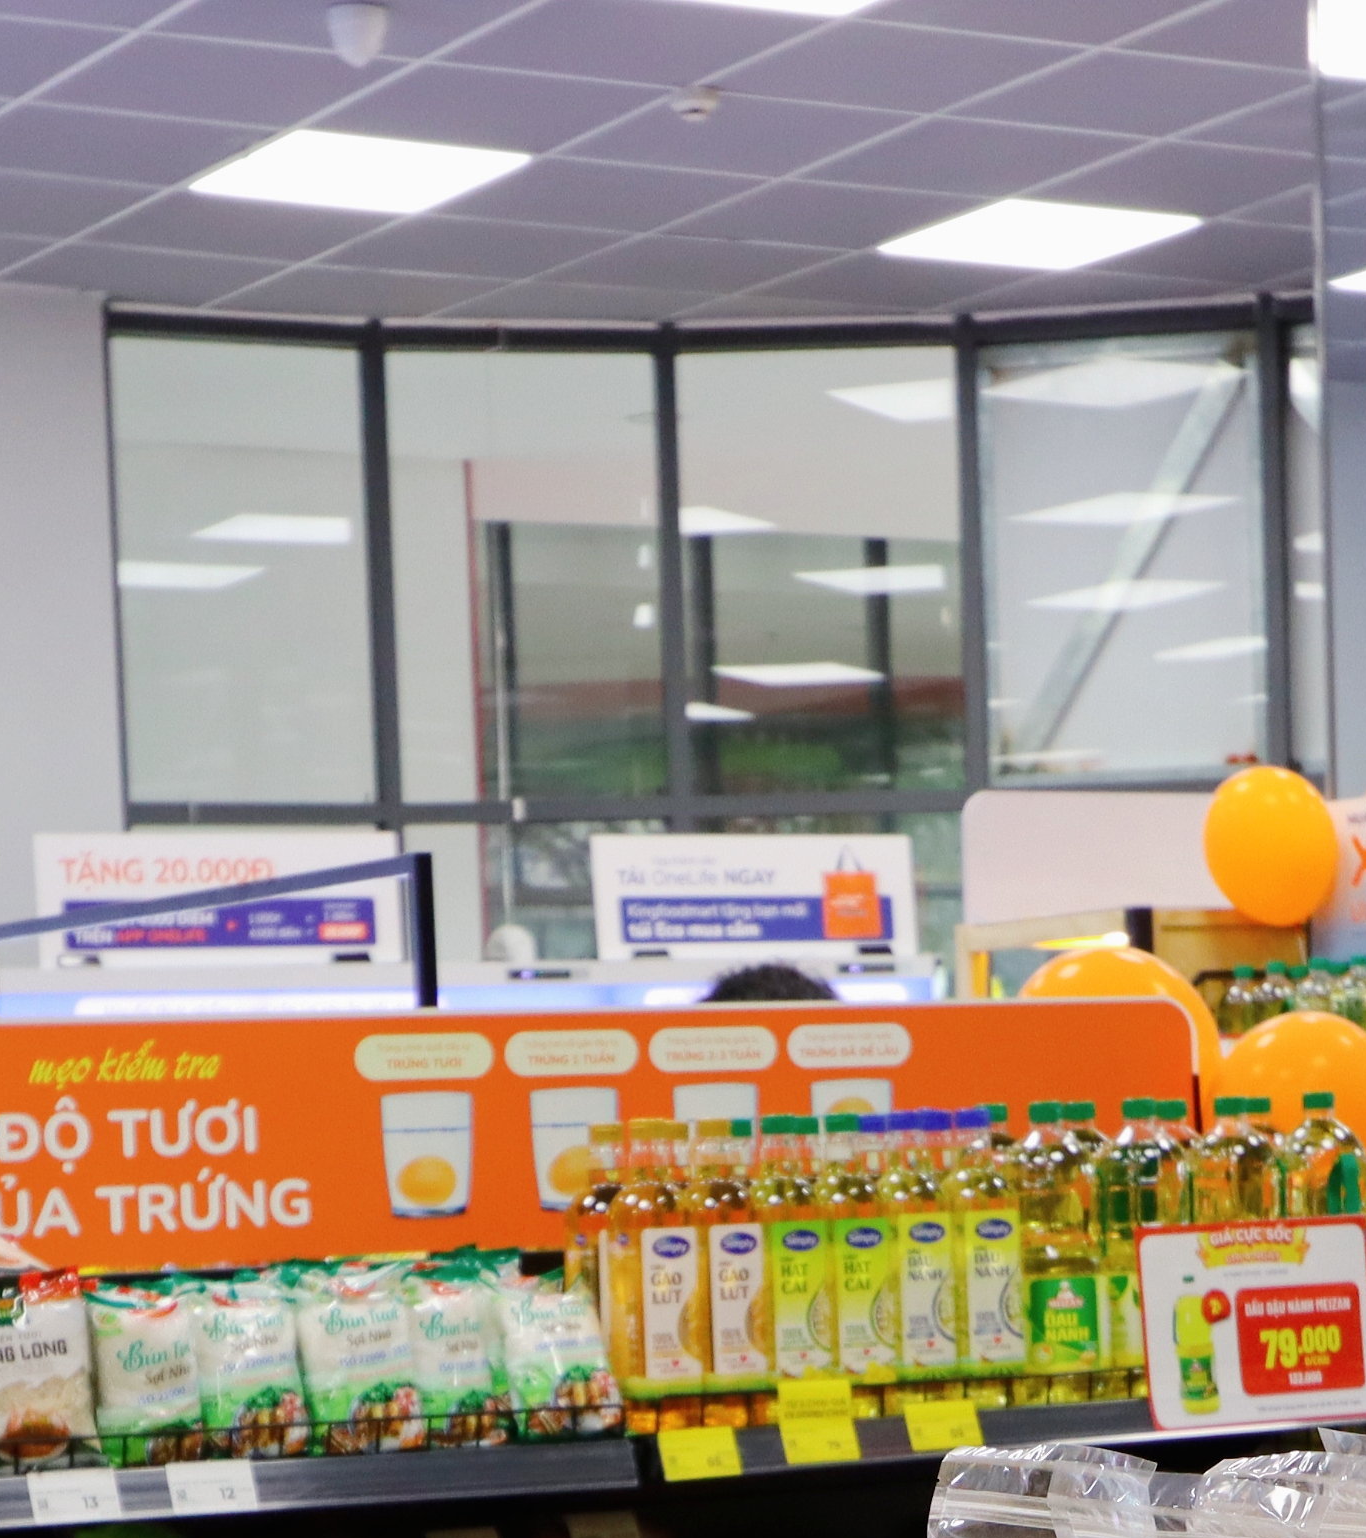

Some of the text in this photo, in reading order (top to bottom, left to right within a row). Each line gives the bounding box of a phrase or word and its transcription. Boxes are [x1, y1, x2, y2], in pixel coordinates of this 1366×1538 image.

[59, 851, 145, 892] TẶNG
[724, 867, 776, 886] NGAY
[29, 1056, 92, 1091] mẹo
[173, 1050, 221, 1081] tra
[106, 1097, 259, 1158] TƯƠI
[94, 1166, 313, 1235] TRỨNG
[1209, 1225, 1294, 1247] GIÁ CỰC SỐC
[318, 1307, 367, 1335] Bún
[20, 1338, 69, 1361] LONG
[1259, 1324, 1342, 1370] 79.000
[218, 1487, 235, 1500] 12
